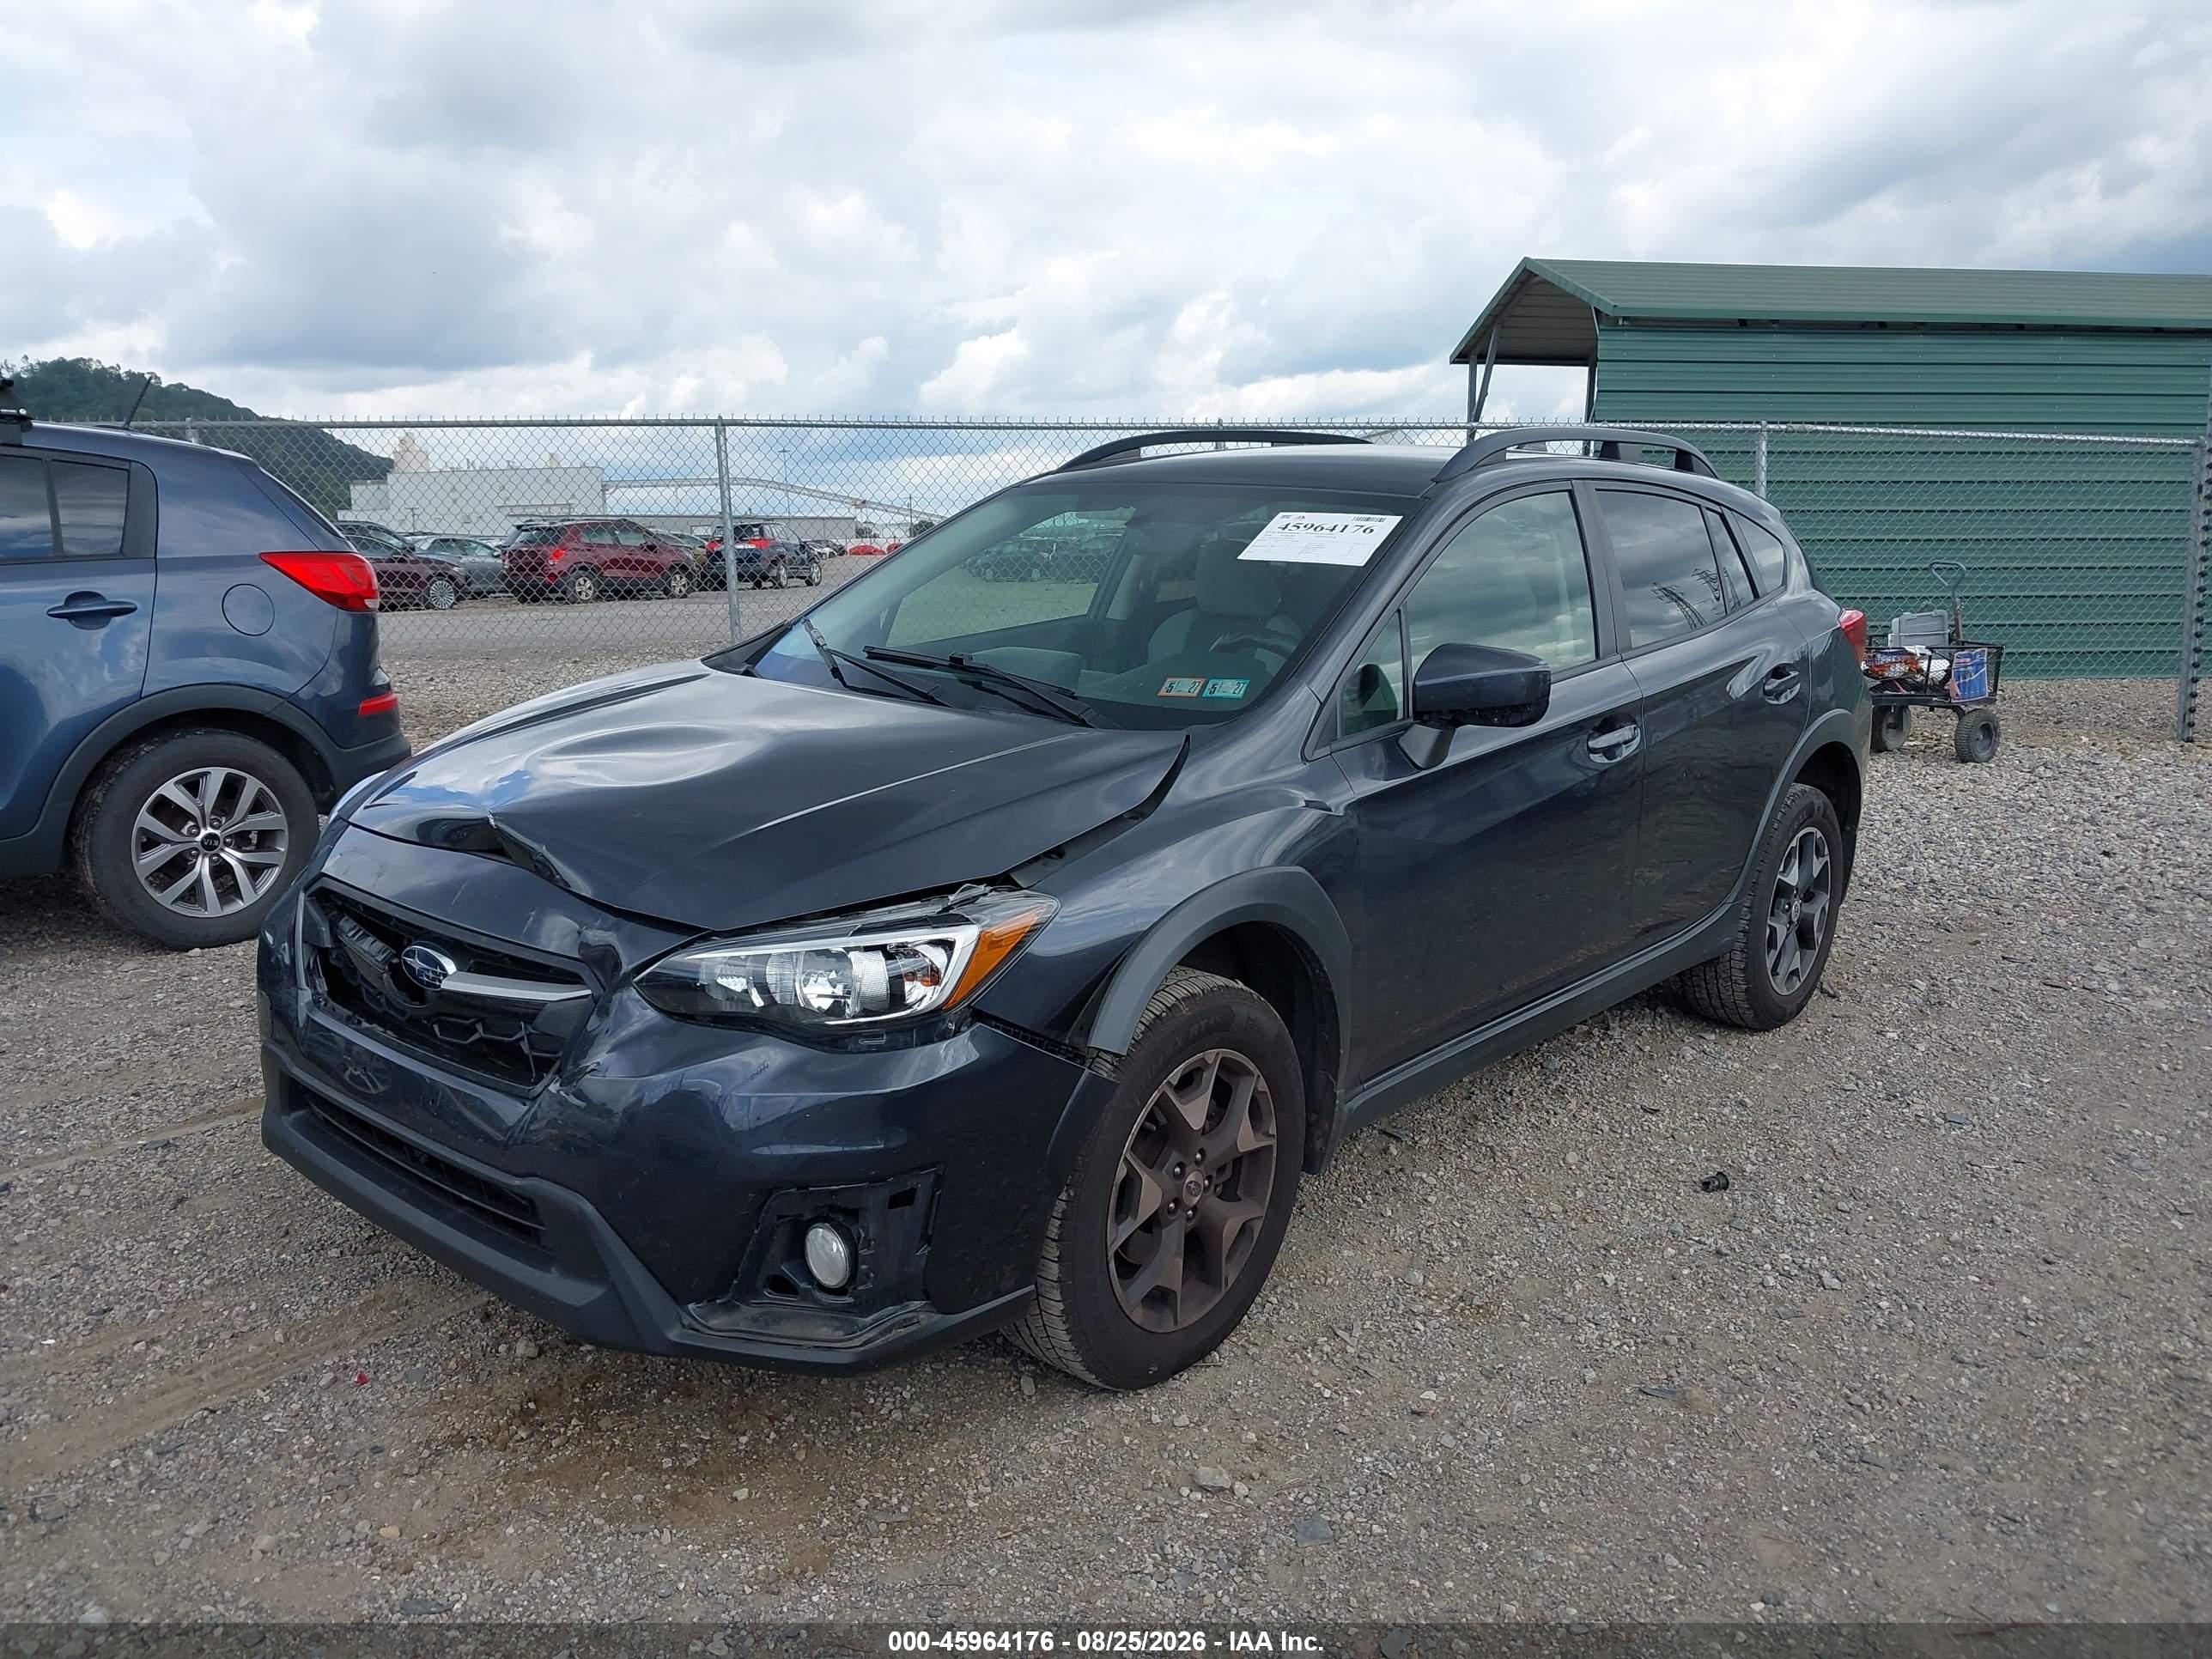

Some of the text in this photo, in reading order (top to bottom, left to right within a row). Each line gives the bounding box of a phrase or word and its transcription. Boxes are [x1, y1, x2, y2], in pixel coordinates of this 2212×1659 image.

[1278, 522, 1376, 534] 45964176
[1165, 681, 1200, 694] 5 27
[1208, 682, 1246, 695] 5 27
[204, 838, 219, 847] KIA
